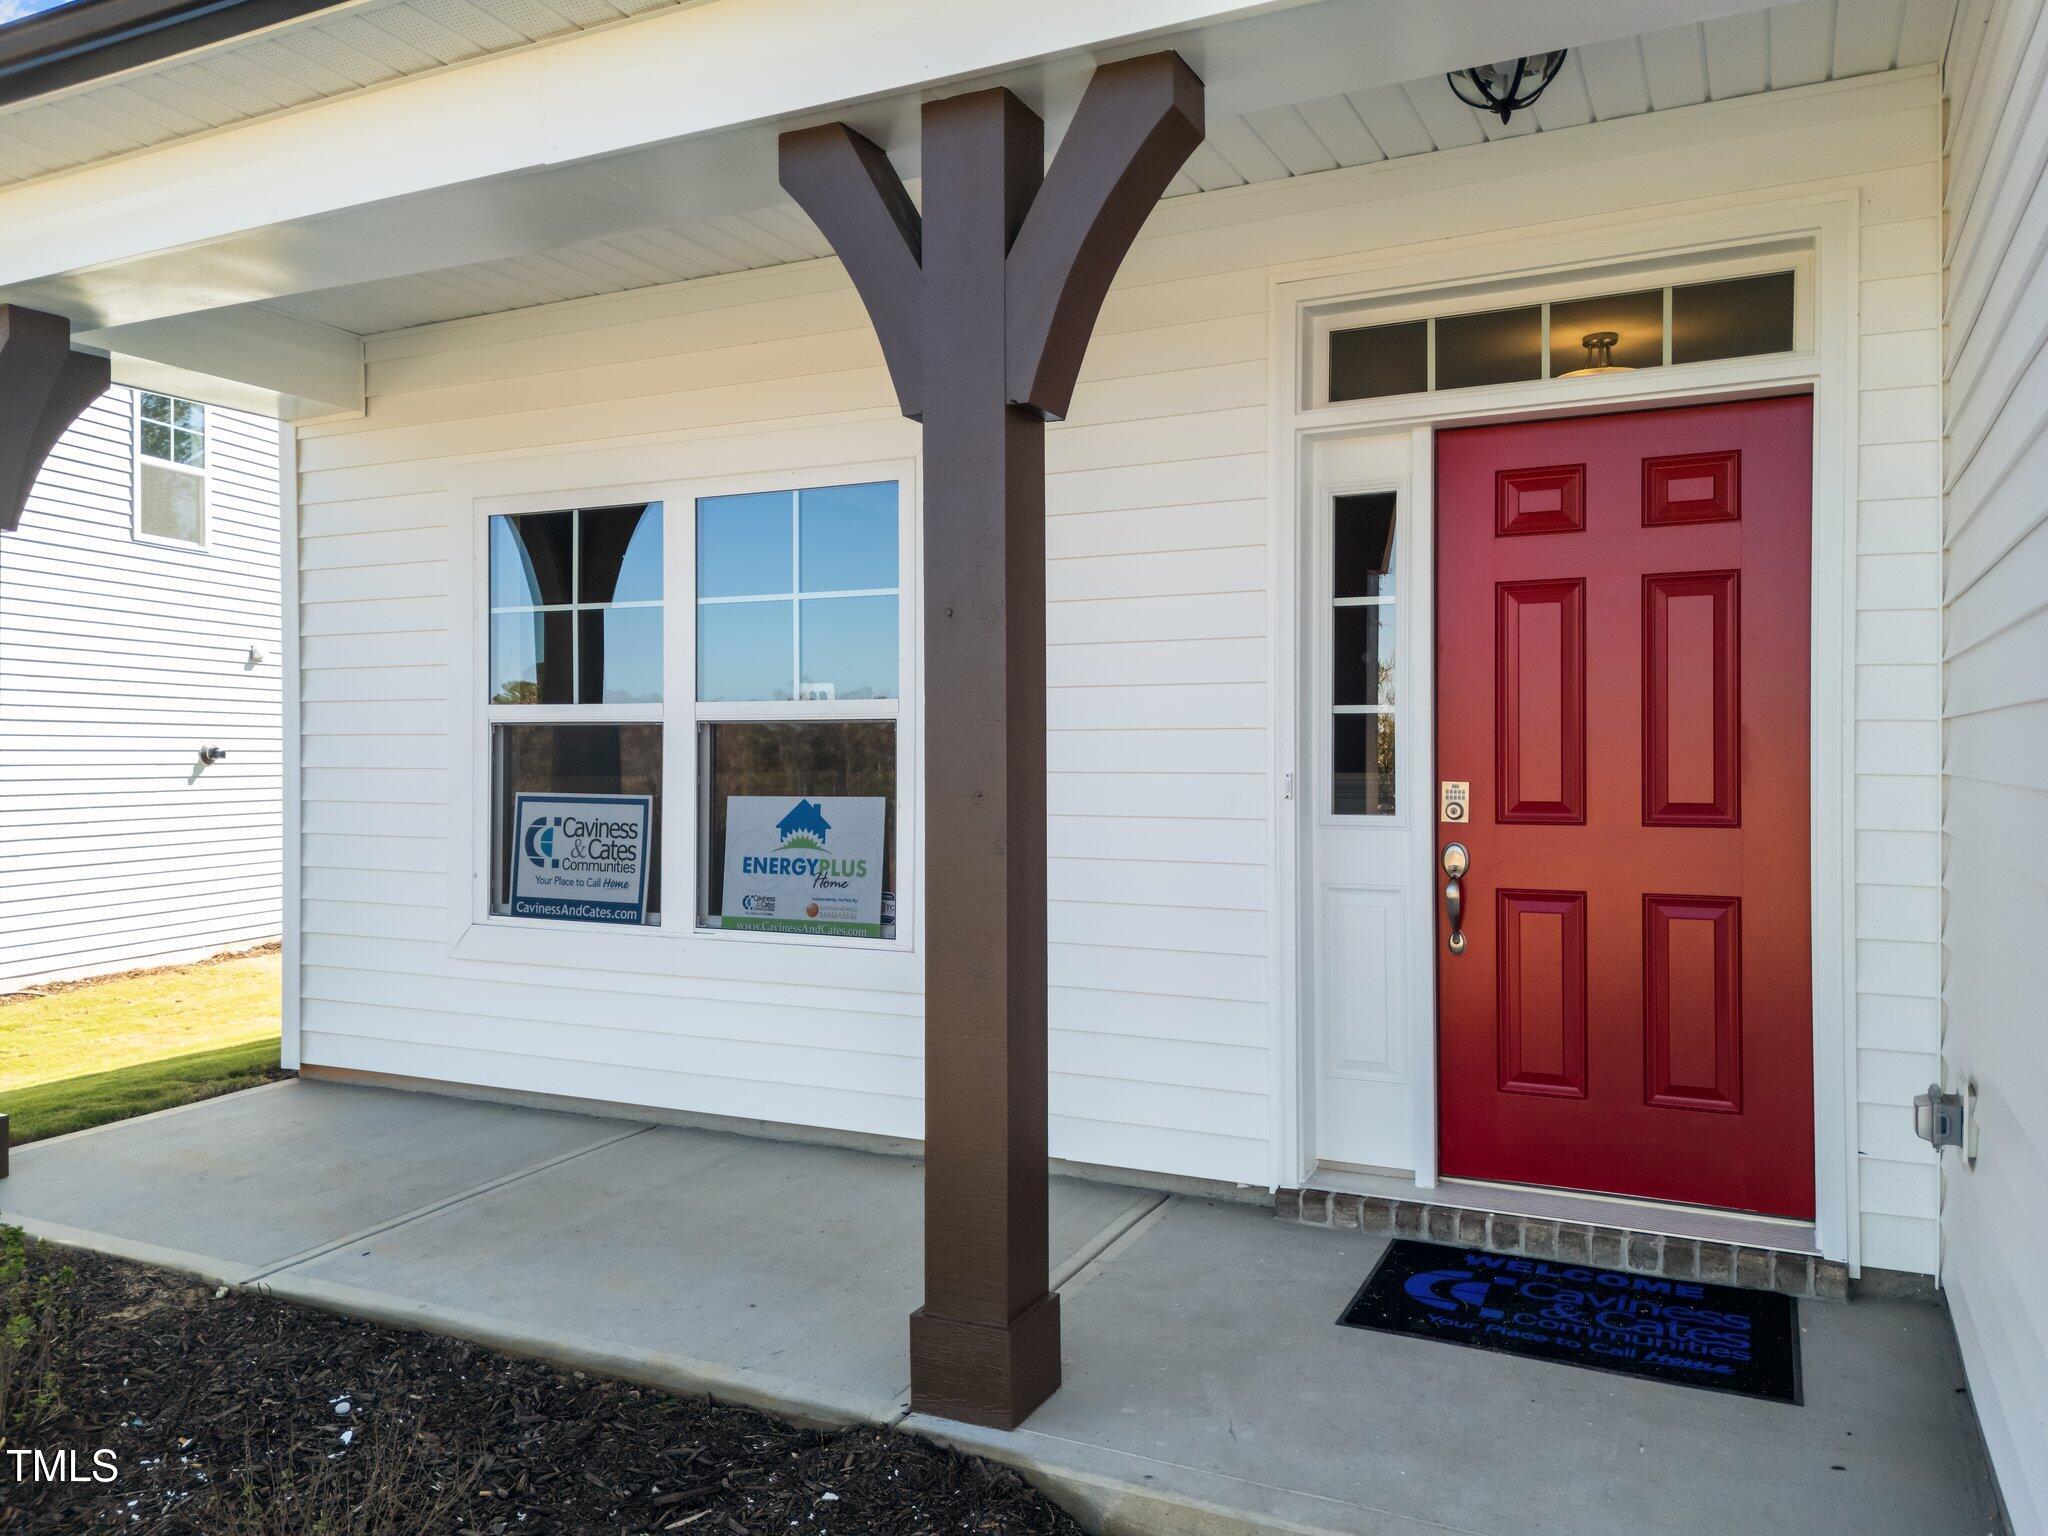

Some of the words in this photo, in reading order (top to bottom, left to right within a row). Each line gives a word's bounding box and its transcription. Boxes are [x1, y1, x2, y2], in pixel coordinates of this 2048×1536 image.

[563, 817, 638, 840] Caviness
[570, 838, 588, 859] &
[588, 838, 637, 861] Cates
[562, 857, 636, 874] Communities
[742, 856, 867, 878] ENERGYPLUS
[535, 875, 552, 885] Your
[554, 876, 574, 887] Place
[576, 877, 585, 887] to
[586, 878, 601, 888] Call
[602, 878, 630, 889] Home
[812, 871, 850, 889] Home
[516, 901, 637, 920] CavinessAndCates.com
[737, 921, 868, 937] www.CavinessAndCates.com
[1464, 1254, 1704, 1299] WELCOME
[1520, 1281, 1751, 1330] Caviness
[1513, 1312, 1752, 1361] Communities
[1539, 1302, 1588, 1324] &
[1595, 1310, 1751, 1349] Cates
[1427, 1313, 1479, 1330] Your
[1485, 1324, 1549, 1343] Place
[1554, 1336, 1582, 1348] to
[1589, 1342, 1636, 1358] Call
[1640, 1351, 1737, 1375] Home
